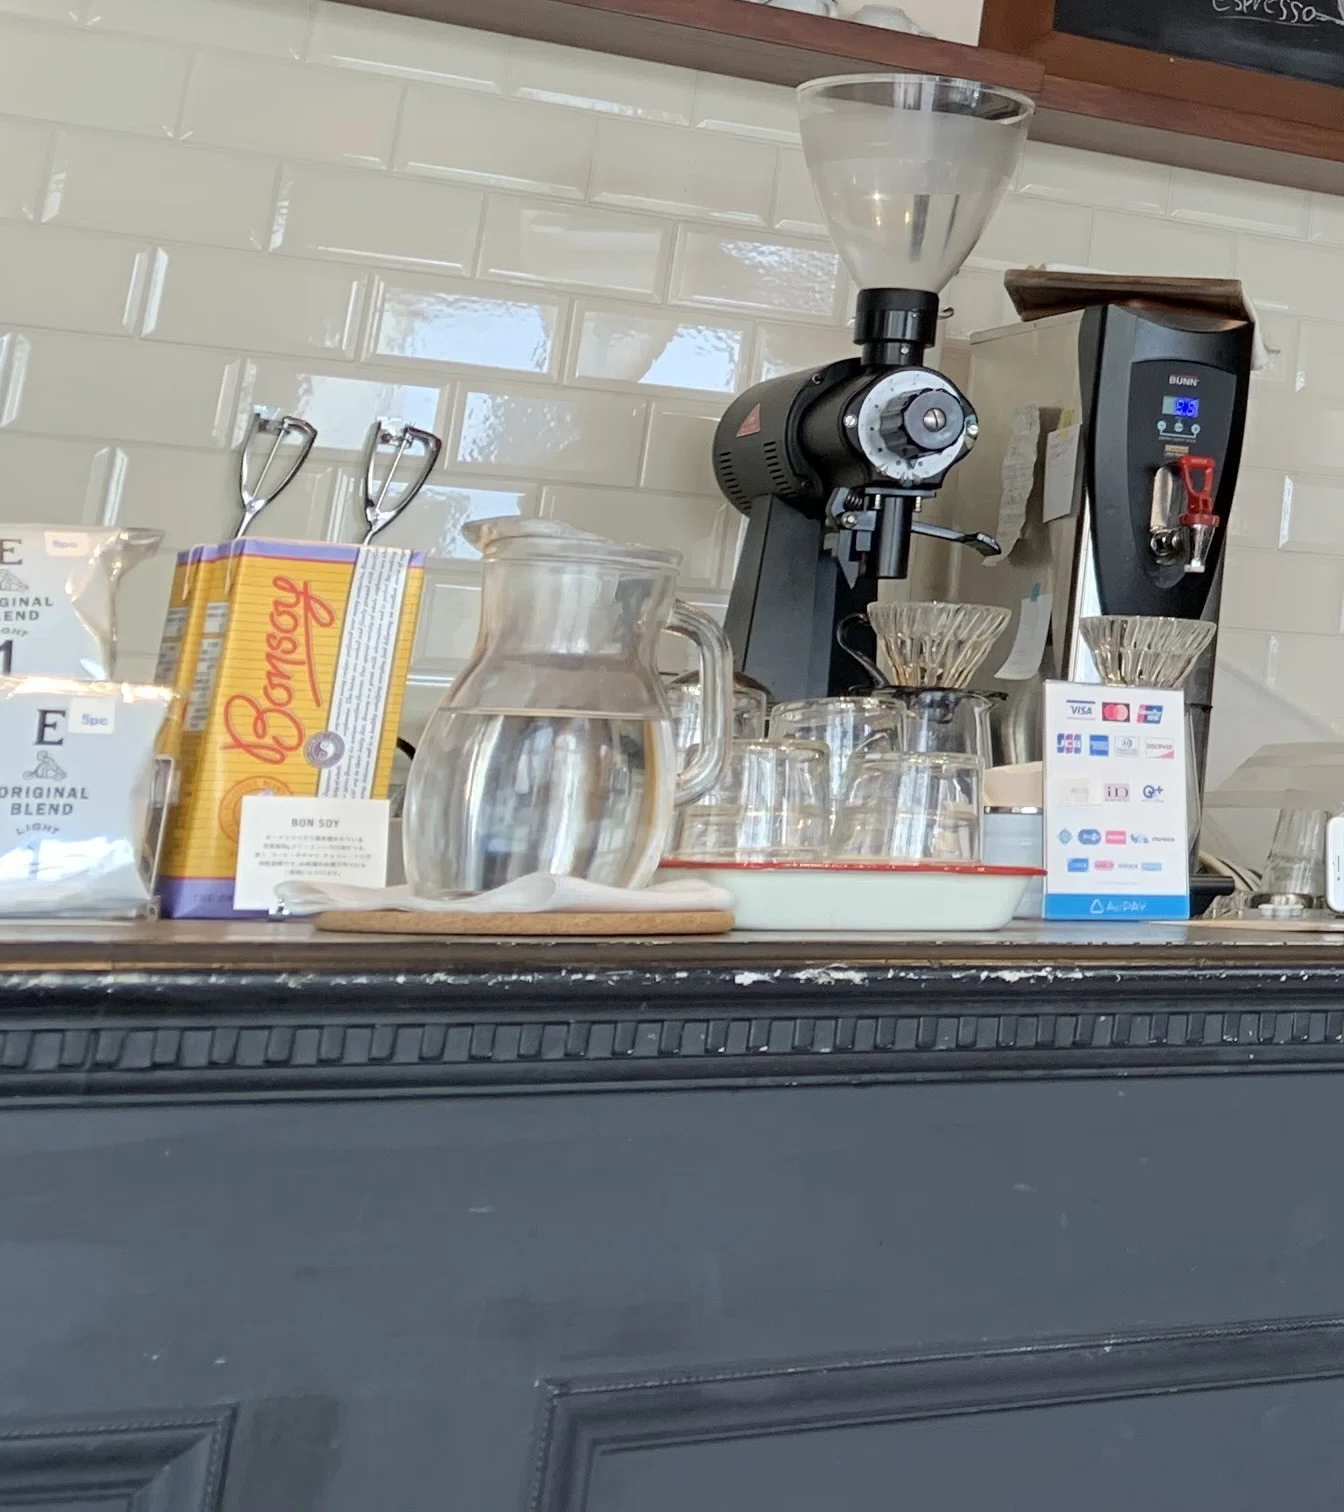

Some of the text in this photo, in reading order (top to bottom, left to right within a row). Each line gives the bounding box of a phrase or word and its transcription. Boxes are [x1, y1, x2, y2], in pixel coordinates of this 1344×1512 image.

[1169, 375, 1198, 387] BUNN
[0, 596, 53, 608] GINAL
[3, 610, 40, 621] END
[220, 575, 336, 766] Bonsoy
[1071, 705, 1093, 716] VISA
[33, 708, 67, 746] E
[10, 803, 74, 816] BLEND
[291, 818, 341, 829] BON SOY
